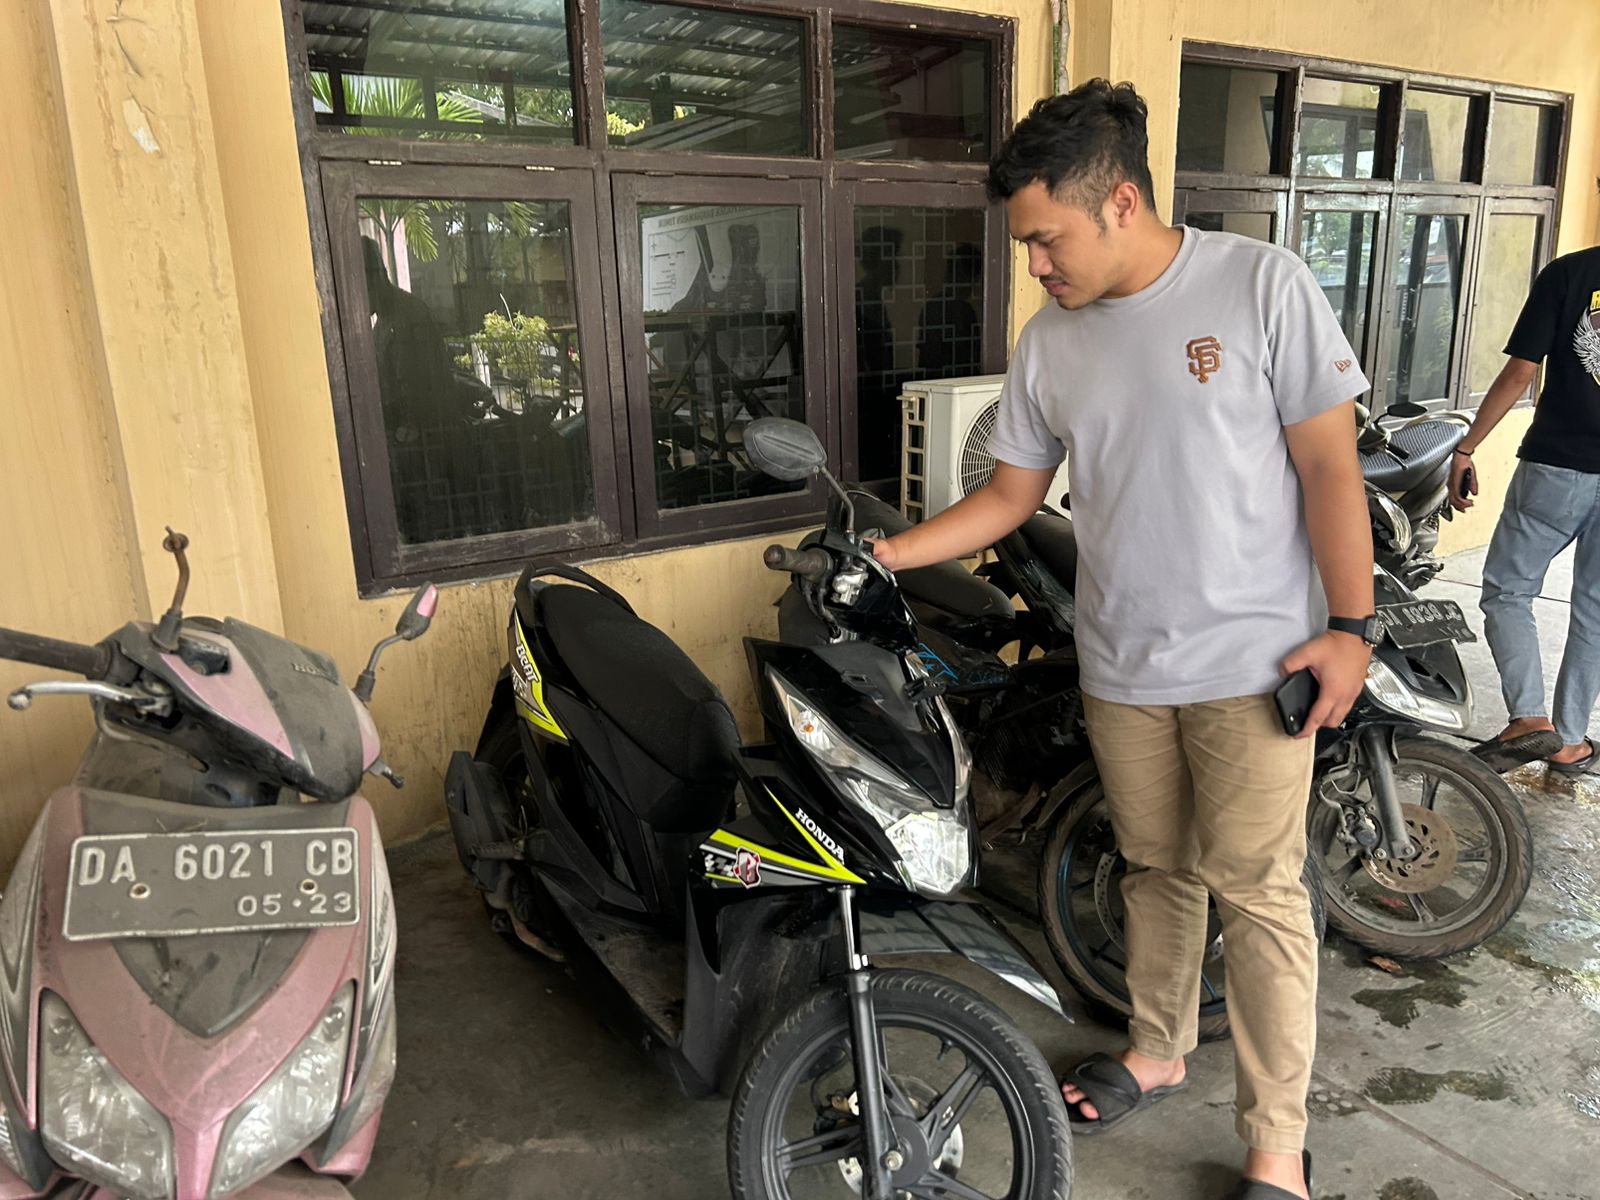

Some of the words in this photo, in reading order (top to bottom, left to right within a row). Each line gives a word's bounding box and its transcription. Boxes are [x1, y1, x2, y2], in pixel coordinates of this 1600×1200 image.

[78, 845, 136, 886] DA
[174, 840, 274, 881] 6021
[306, 838, 352, 877] CB
[795, 808, 846, 864] HONDA
